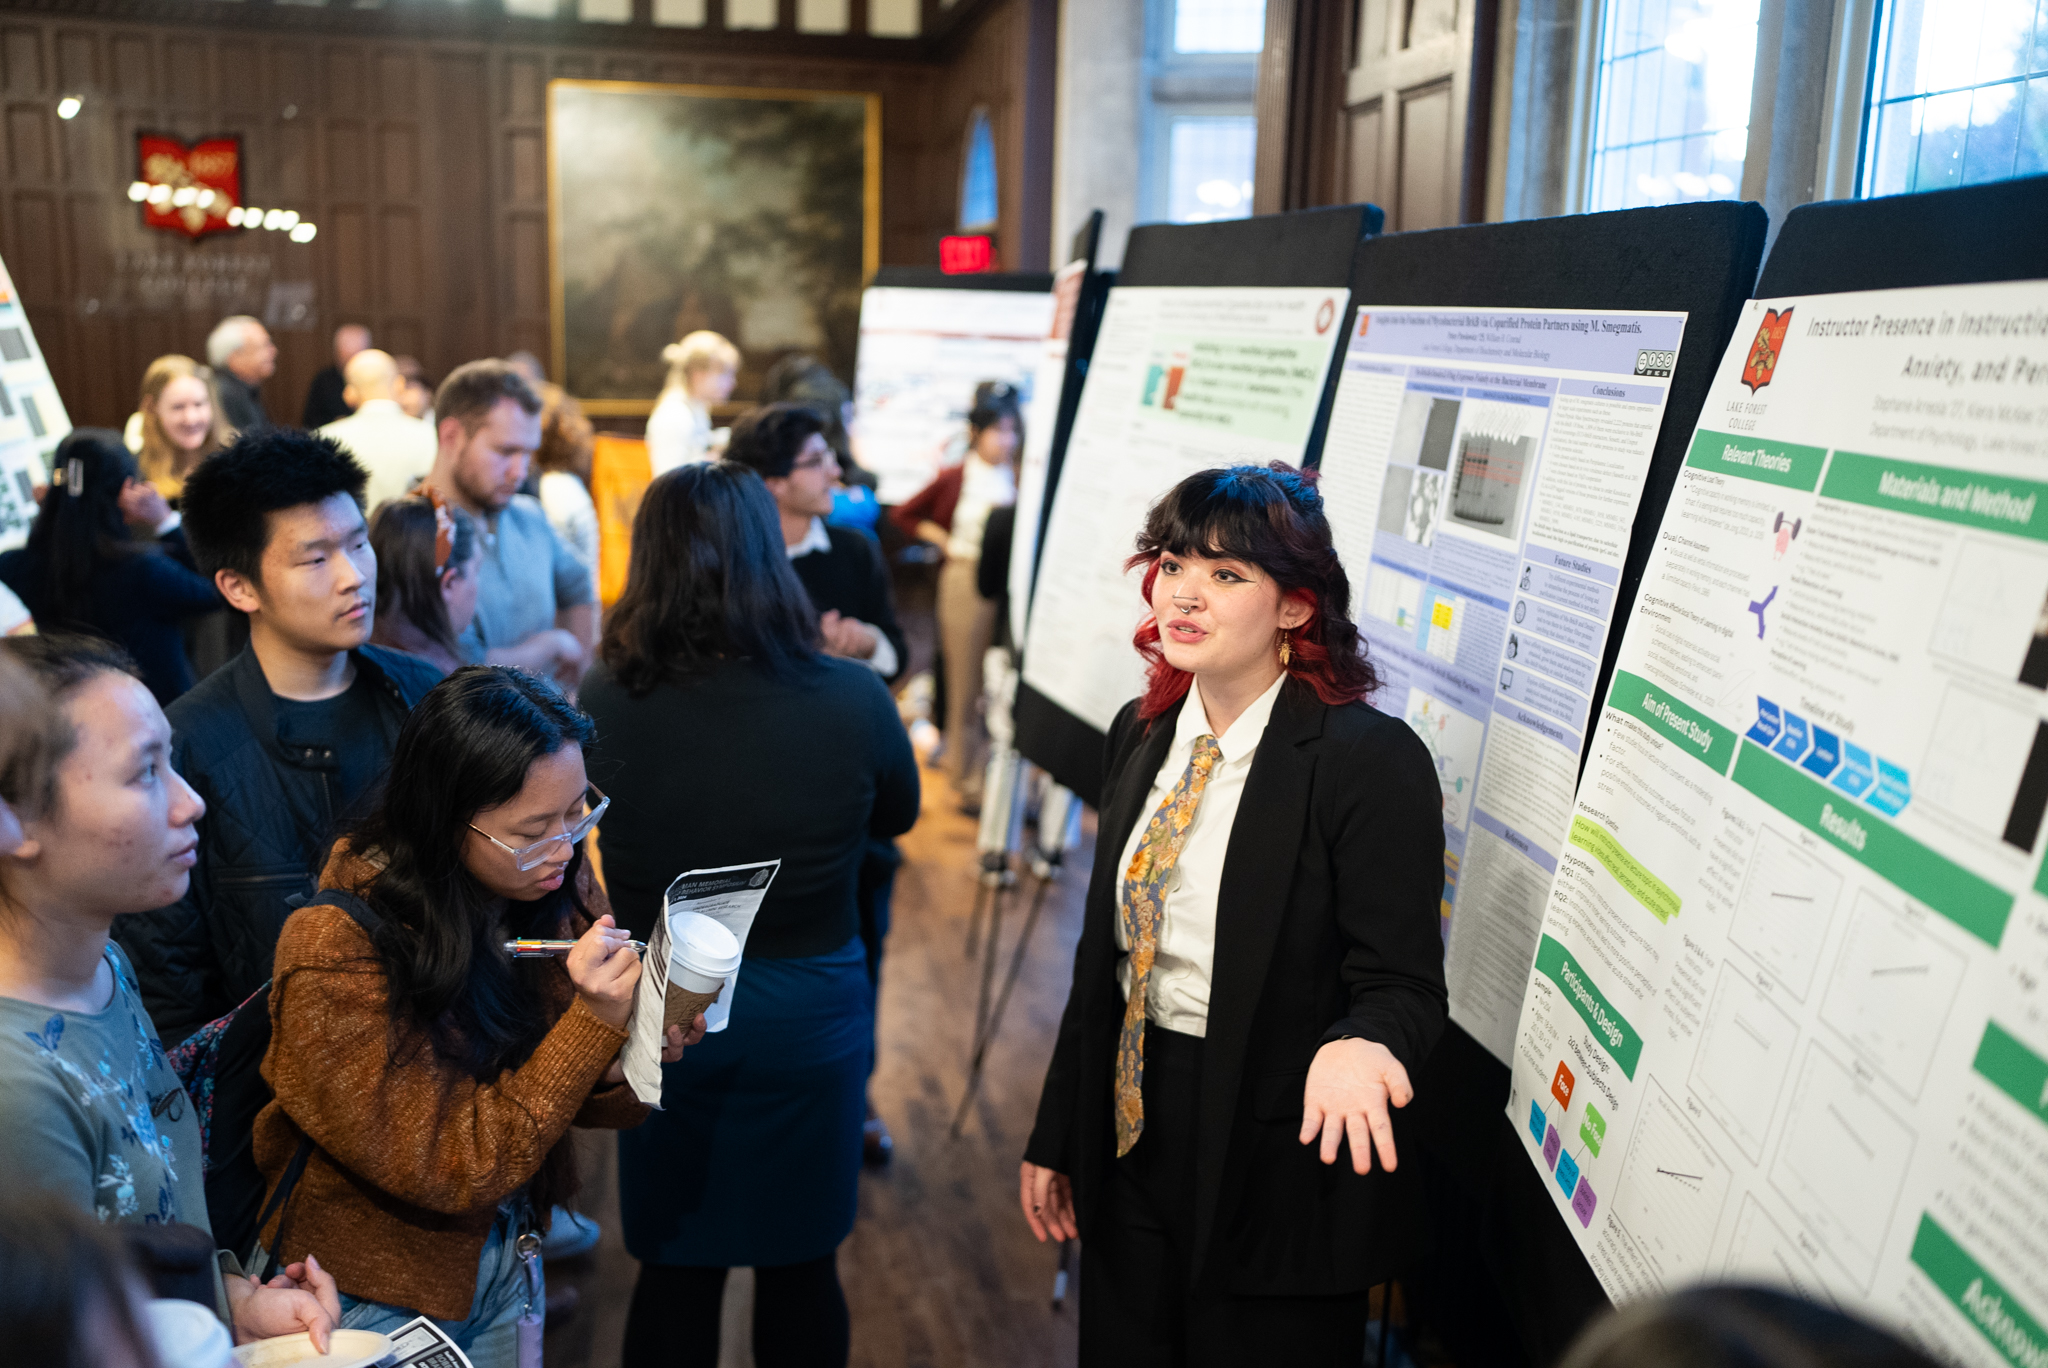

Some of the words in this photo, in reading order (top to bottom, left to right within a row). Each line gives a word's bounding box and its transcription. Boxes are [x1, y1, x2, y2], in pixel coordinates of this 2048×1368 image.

[1521, 318, 1541, 330] Protein
[1543, 319, 1569, 331] Partners
[1571, 320, 1589, 335] using
[1591, 320, 1600, 332] M.
[1602, 320, 1642, 336] Smegmatis.
[1806, 316, 1868, 338] Instructor
[1870, 314, 1935, 338] Presence
[1901, 354, 1965, 386] Anxiety,
[1970, 354, 2011, 384] and
[1592, 385, 1626, 398] Conclusions
[1726, 401, 1742, 414] LAKE
[1744, 402, 1767, 415] FOREST
[1728, 417, 1756, 431] COLLEGE
[1721, 444, 1755, 467] Relevant
[1754, 448, 1793, 473] Theories
[1683, 469, 1706, 481] Cognitive
[1878, 470, 1940, 506] Materials
[1940, 482, 1973, 512] and
[1970, 484, 2038, 525] Method
[1663, 531, 1678, 542] Dual
[1554, 554, 1572, 568] Future
[1571, 560, 1591, 574] Studies
[1644, 593, 1670, 609] Cognitive
[1605, 711, 1623, 726] What
[1641, 692, 1657, 714] Aim
[1653, 702, 1666, 718] of
[1661, 704, 1691, 736] Present
[1687, 721, 1714, 753] Study
[1613, 728, 1625, 740] Few
[1605, 754, 1616, 766] For
[1578, 800, 1606, 820] Research
[1574, 818, 1590, 833] How
[1820, 802, 1868, 853] Results
[1570, 831, 1595, 853] learning
[1560, 864, 1575, 878] RQ1
[682, 886, 711, 895] BEHAVIOR
[698, 878, 731, 887] MEMORIAL
[1557, 878, 1576, 893] either
[1551, 902, 1573, 924] learning
[1560, 960, 1595, 1014] Participants
[1592, 1001, 1600, 1021] &
[1596, 1007, 1624, 1048] Design
[1583, 1034, 1593, 1057] Study
[1557, 1073, 1570, 1097] Face
[1605, 1086, 1619, 1111] Design
[1582, 1109, 1592, 1131] No
[1589, 1121, 1603, 1148] Face
